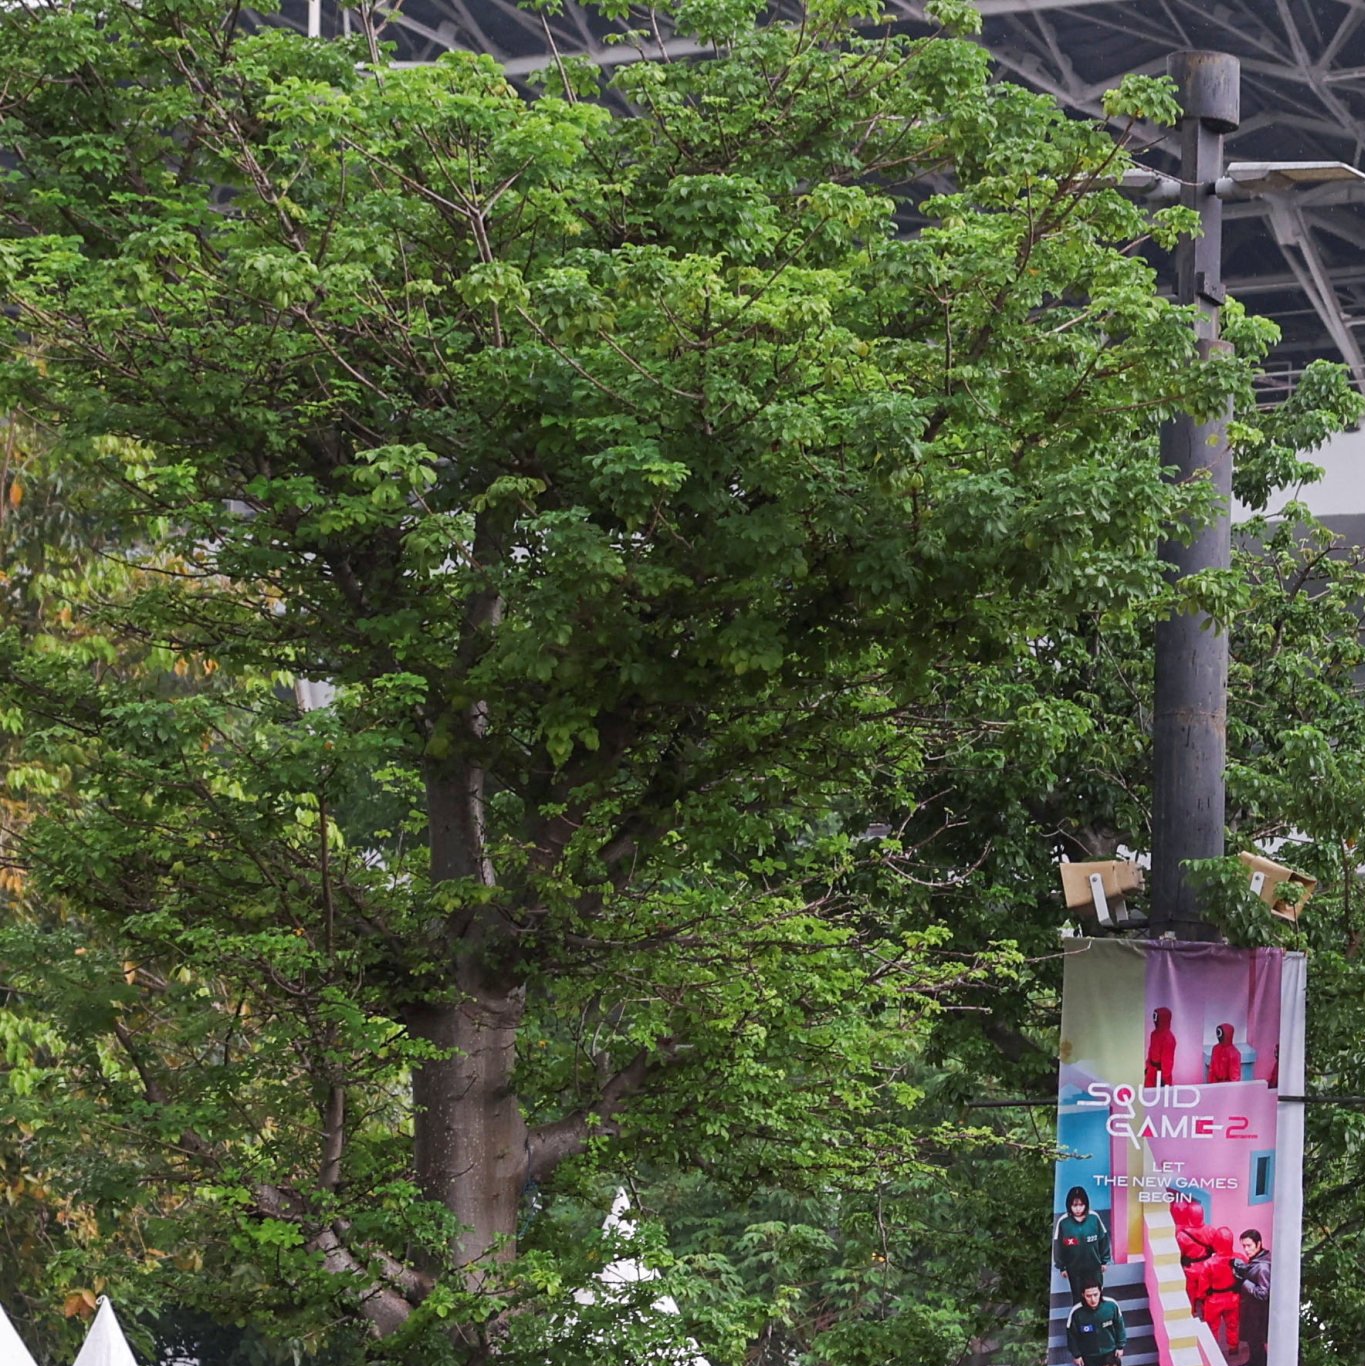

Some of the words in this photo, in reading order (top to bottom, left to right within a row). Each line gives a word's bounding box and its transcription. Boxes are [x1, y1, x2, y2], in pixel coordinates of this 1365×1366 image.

[1077, 1070, 1201, 1113] SQUID
[1105, 1114, 1224, 1150] GAME
[1225, 1116, 1259, 1139] 2
[1152, 1162, 1185, 1173] LET
[1093, 1175, 1128, 1187] THE
[1132, 1177, 1172, 1188] NEW
[1175, 1178, 1238, 1189] GAMES
[1138, 1192, 1192, 1203] BEGIN
